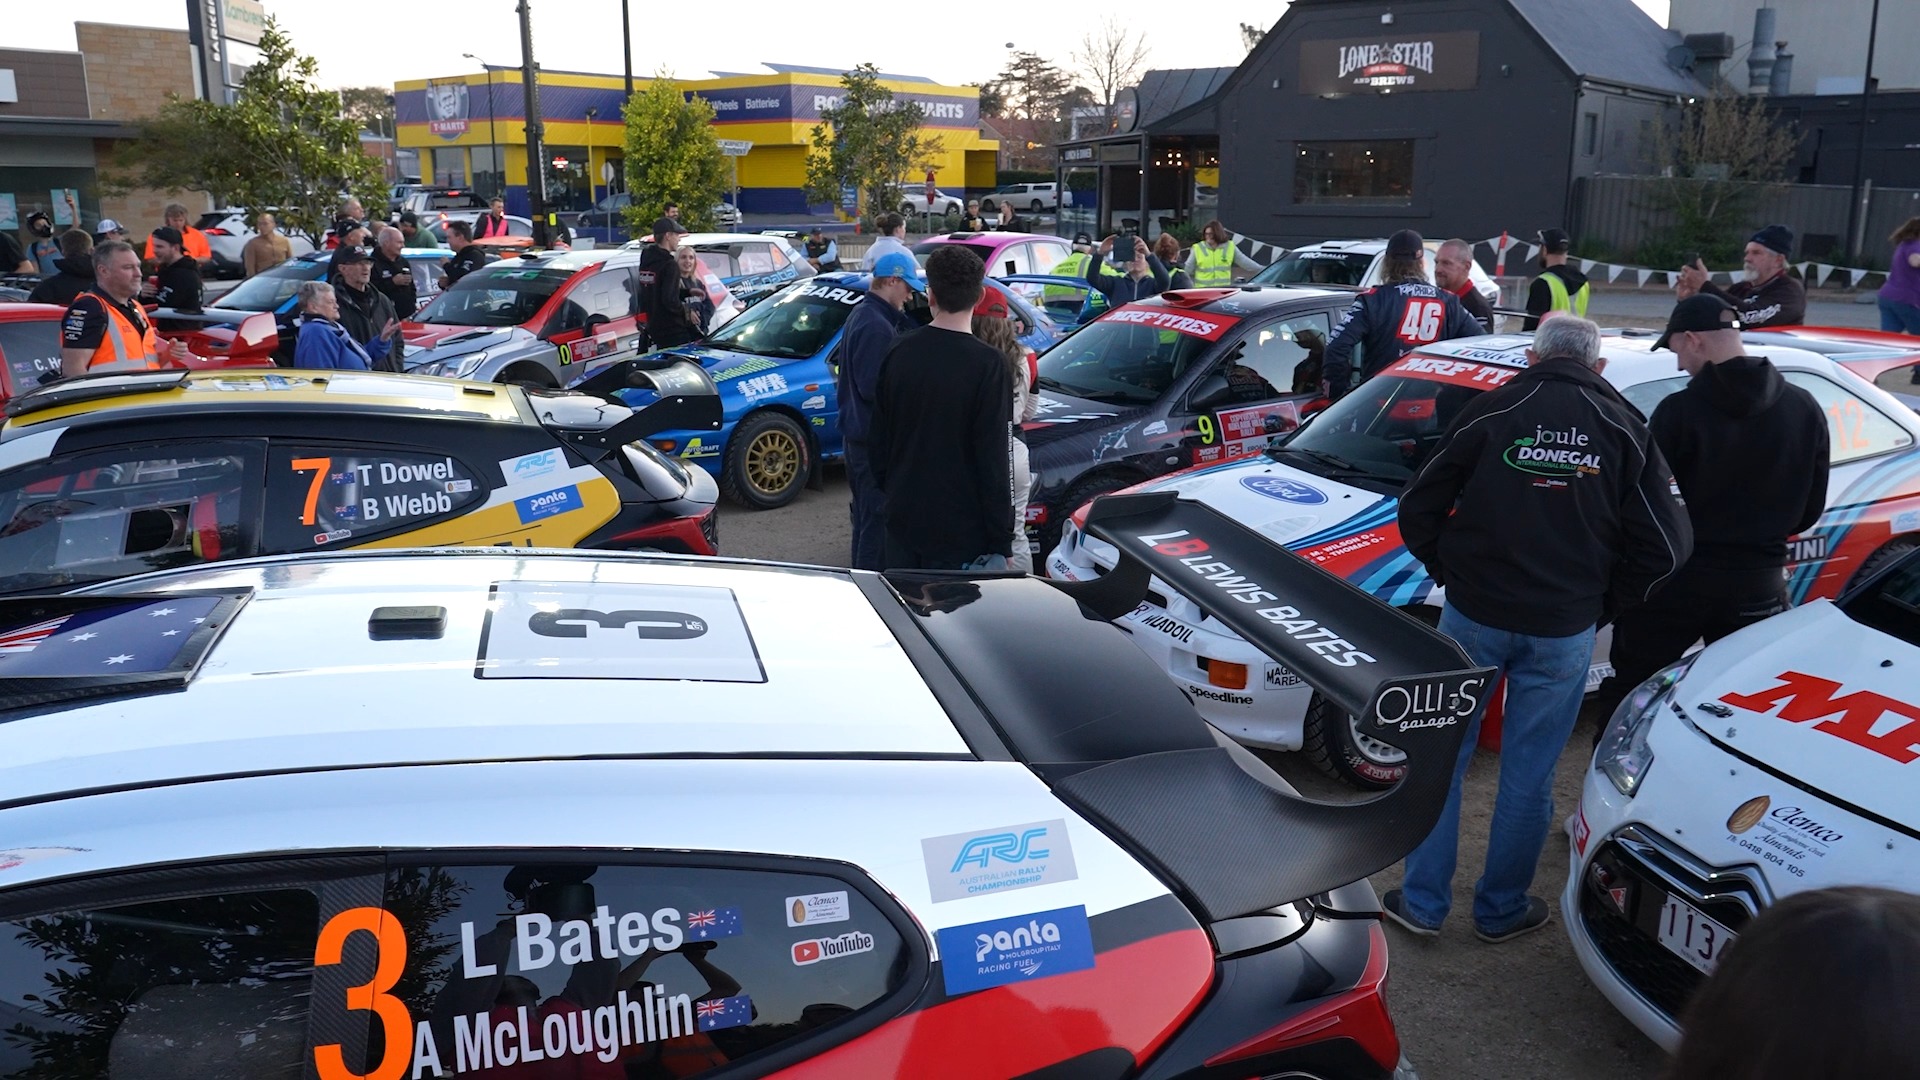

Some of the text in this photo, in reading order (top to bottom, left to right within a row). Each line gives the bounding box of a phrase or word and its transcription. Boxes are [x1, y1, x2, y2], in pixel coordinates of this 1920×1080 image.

[1338, 41, 1433, 78] LONE STAR
[1370, 75, 1415, 86] BREWS
[711, 98, 780, 110] Wheels Batteries
[433, 121, 465, 131] T-MARTS
[1104, 311, 1219, 336] MRF TYRES
[1400, 301, 1442, 342] 46
[1395, 358, 1519, 386] MRF TY
[737, 373, 788, 397] LWR
[1198, 415, 1215, 444] 9
[1533, 424, 1589, 447] joule
[1828, 399, 1869, 450] 12
[513, 451, 556, 473] ARC
[1199, 446, 1221, 456] MRF
[1518, 447, 1600, 469] DONEGAL
[357, 457, 454, 486] T Dowel
[1516, 460, 1559, 469] INTERNATIONAL
[1560, 463, 1578, 471] RALLY
[291, 457, 331, 526] 7
[530, 491, 567, 511] panta
[1252, 480, 1311, 499] Ford
[362, 491, 451, 520] B Webb
[327, 530, 350, 541] YouTube
[1322, 537, 1360, 552] WILSON
[1330, 541, 1371, 556] THOMAS
[1180, 555, 1278, 604] LEWIS
[1256, 606, 1377, 667] BATES
[529, 609, 708, 640] 3
[1189, 685, 1253, 704] speedline
[1399, 716, 1457, 732] garage
[1771, 806, 1843, 842] Clemco
[950, 828, 1050, 873] ARC
[1755, 834, 1806, 860] Almonds
[1758, 822, 1825, 858] Quality Langhorne Creek
[1740, 840, 1762, 855] 0418
[1764, 852, 1784, 866] 804
[1787, 864, 1805, 878] 105
[960, 865, 1047, 886] AUSTRALIAN RALLY
[968, 874, 1042, 893] CHAMPIONSHIP
[808, 896, 839, 907] Clemco
[461, 904, 684, 979] L Bates
[821, 934, 872, 957] YouTube
[975, 920, 1060, 963] panta
[978, 958, 1035, 975] RACING FUEL
[313, 907, 414, 1080] 3
[412, 984, 695, 1080] A McLoughlin
